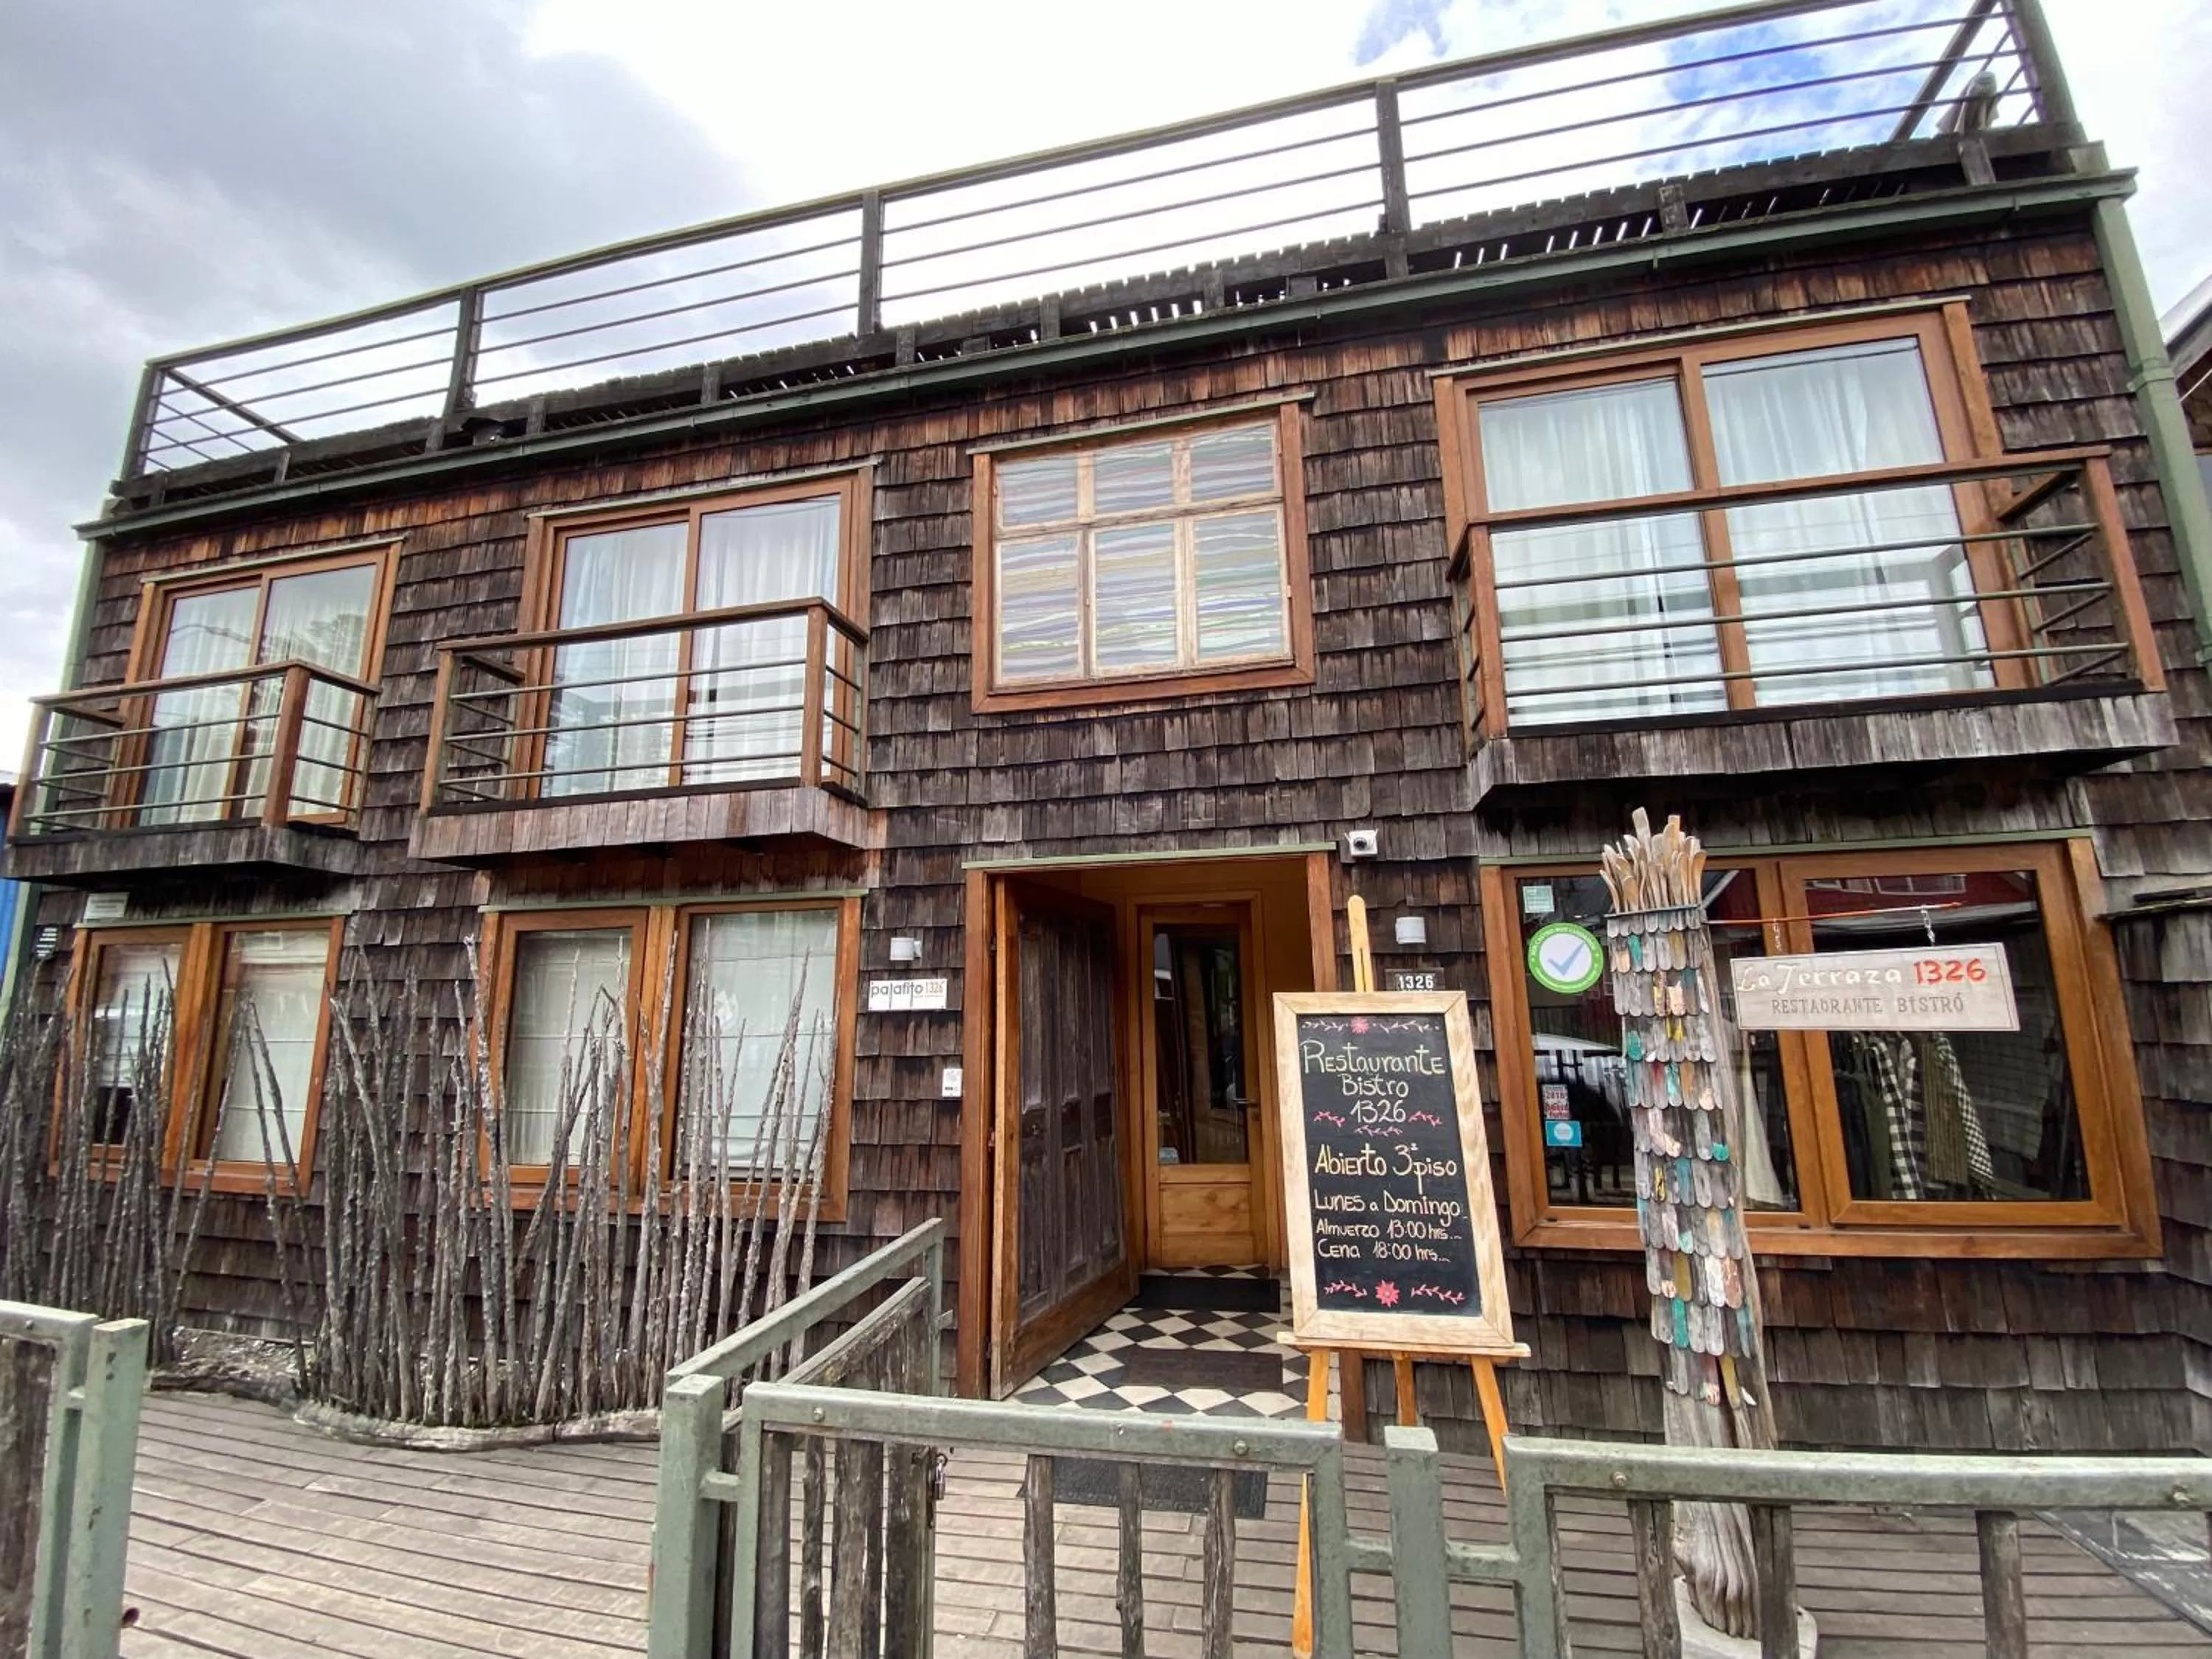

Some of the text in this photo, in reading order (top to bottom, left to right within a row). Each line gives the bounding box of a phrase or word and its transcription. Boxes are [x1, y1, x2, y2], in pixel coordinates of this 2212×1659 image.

[1399, 975, 1434, 989] 1326
[1736, 958, 1986, 995] La Terraza 1326
[871, 981, 924, 1009] palafito
[1771, 997, 1883, 1015] RESTAURANTE
[1301, 1038, 1446, 1075] Restaurante
[1338, 1073, 1409, 1097] Bistro
[1350, 1099, 1406, 1123] 1326
[1315, 1142, 1387, 1176] Abierto
[1412, 1157, 1457, 1195] piso
[1313, 1189, 1461, 1227] Lunes a Domingo
[1315, 1217, 1380, 1238] Almuerzo
[1387, 1219, 1426, 1239] 13:00
[1317, 1238, 1361, 1259] Cena
[1372, 1240, 1412, 1260] 18:00
